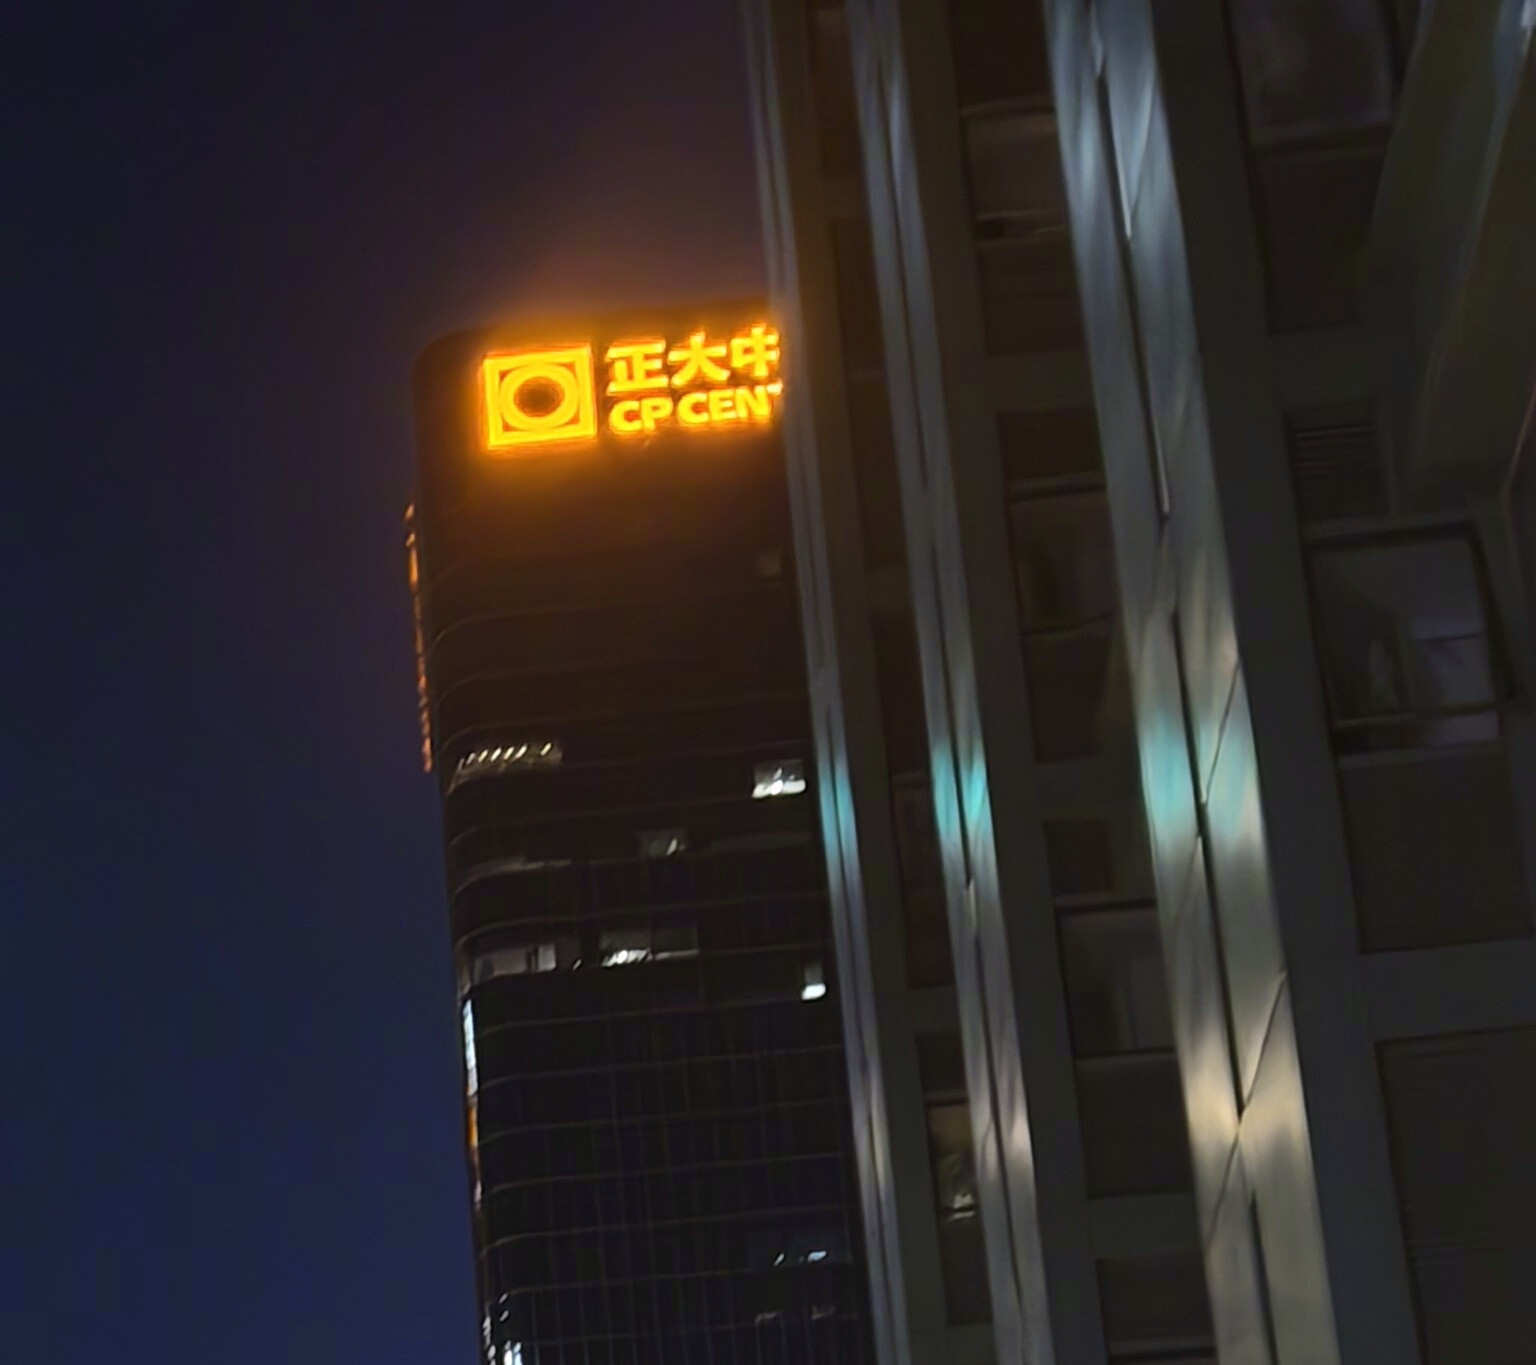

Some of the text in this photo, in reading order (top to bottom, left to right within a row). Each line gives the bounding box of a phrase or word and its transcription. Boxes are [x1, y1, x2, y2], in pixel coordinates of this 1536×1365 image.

[606, 326, 780, 394] 正大中
[609, 397, 673, 432] CP
